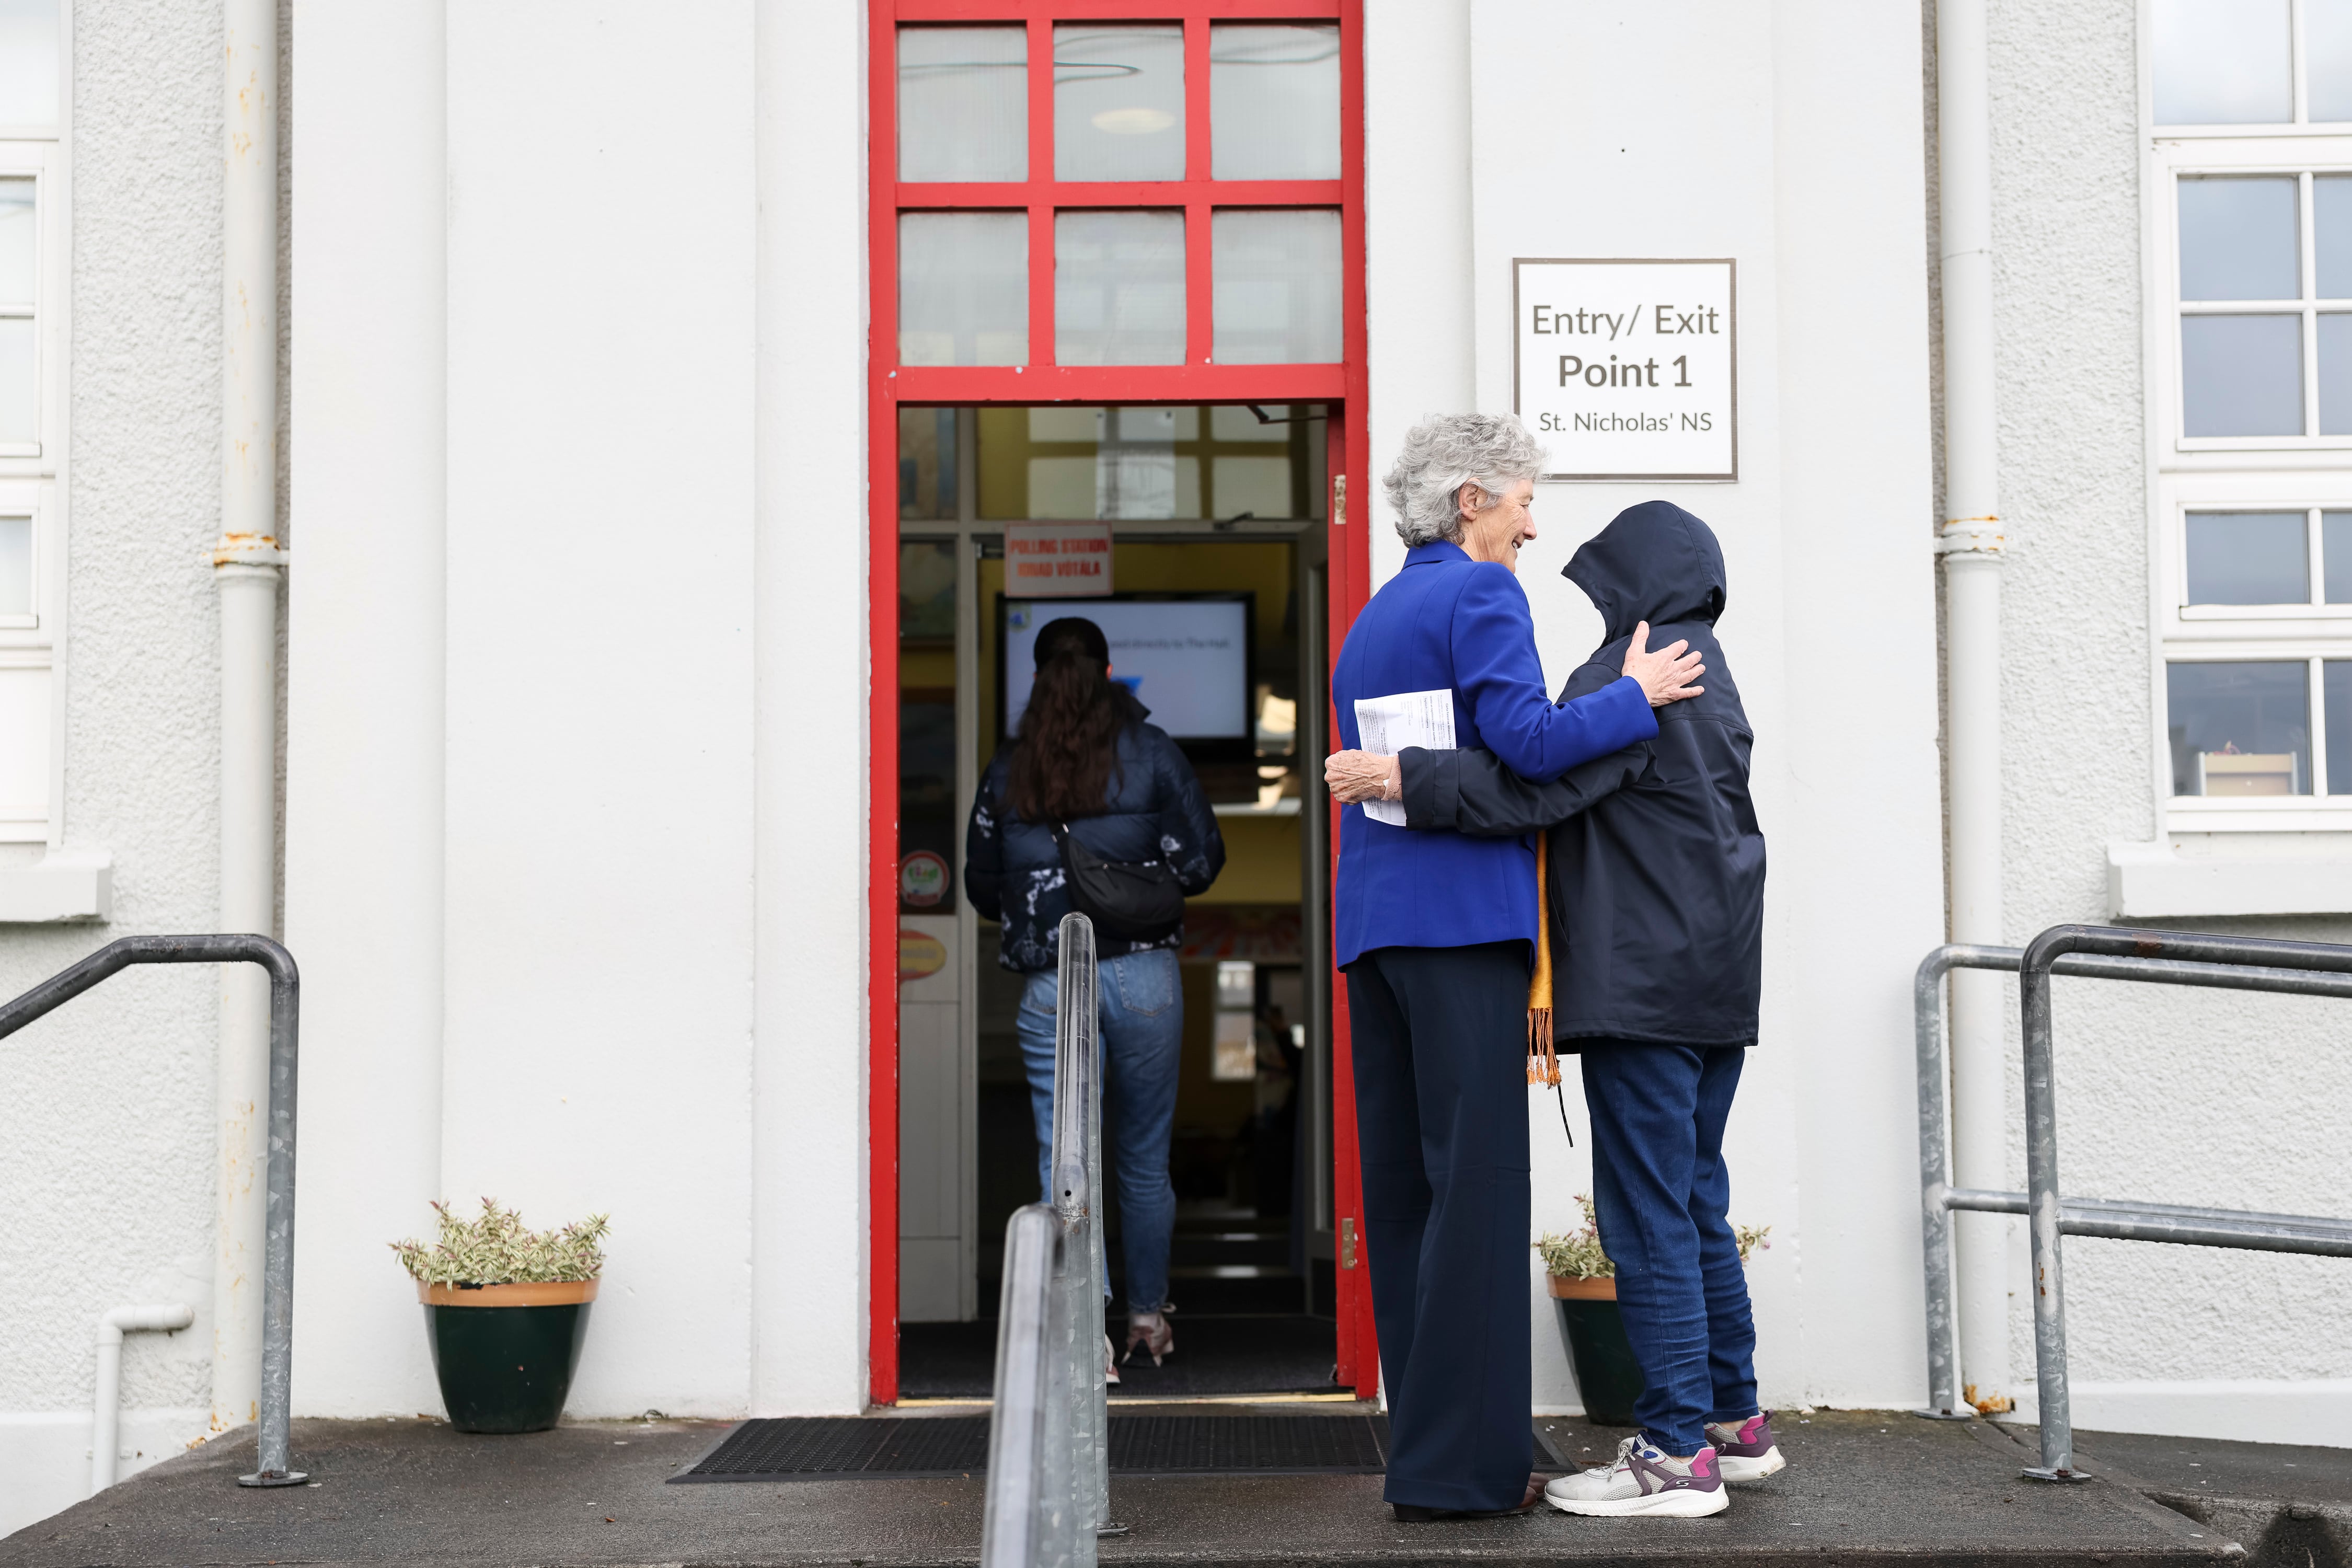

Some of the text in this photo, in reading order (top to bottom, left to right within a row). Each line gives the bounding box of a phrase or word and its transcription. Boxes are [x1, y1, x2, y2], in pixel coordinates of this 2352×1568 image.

[1533, 304, 1719, 341] Entry/ Exit
[1559, 354, 1692, 387] Point 1
[1540, 412, 1712, 431] St. Nicholas' NS
[1011, 538, 1108, 554] POLLING STATION
